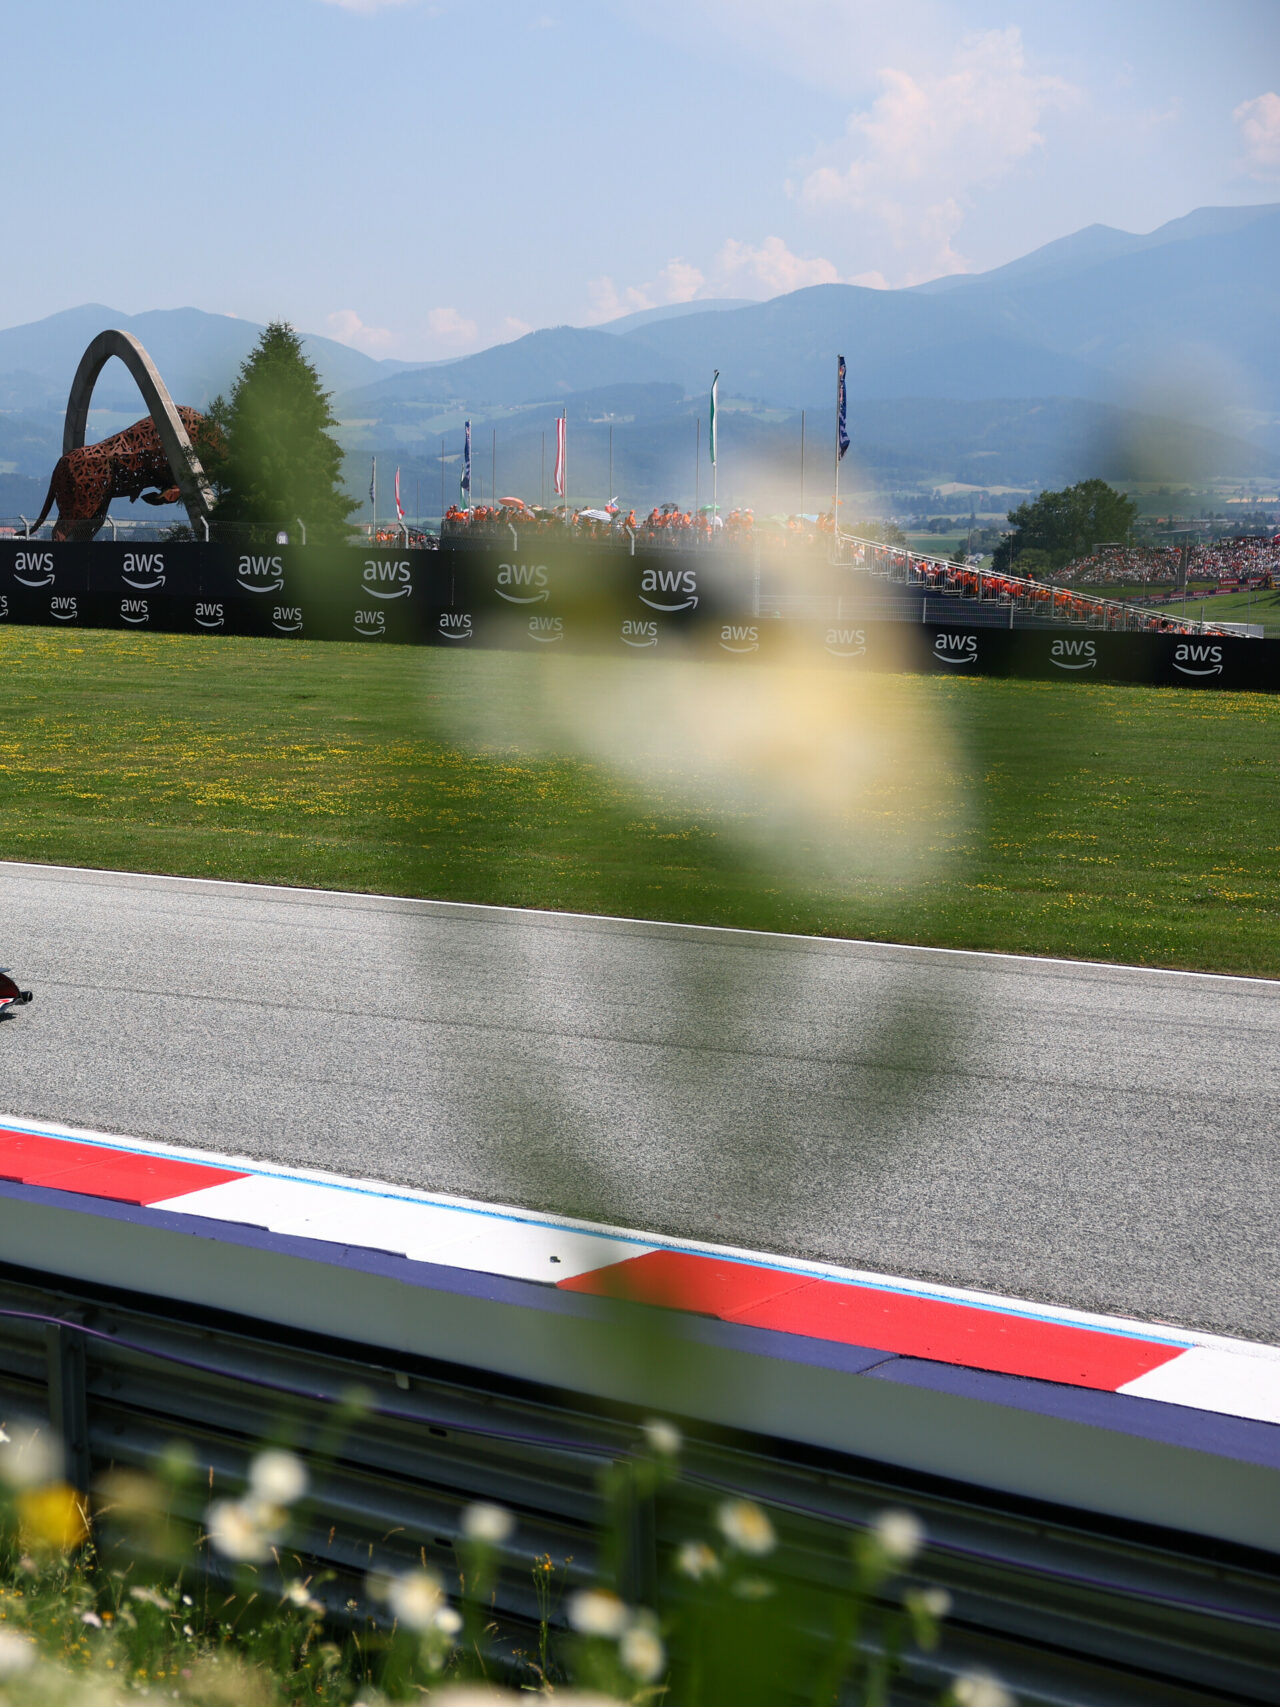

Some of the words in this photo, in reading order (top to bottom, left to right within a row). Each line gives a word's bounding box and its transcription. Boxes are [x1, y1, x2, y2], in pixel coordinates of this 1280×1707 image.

[15, 552, 53, 571] aws
[123, 552, 164, 572] aws
[238, 556, 282, 576] aws
[363, 560, 410, 582] aws
[497, 563, 548, 586] aws
[641, 569, 697, 592] aws
